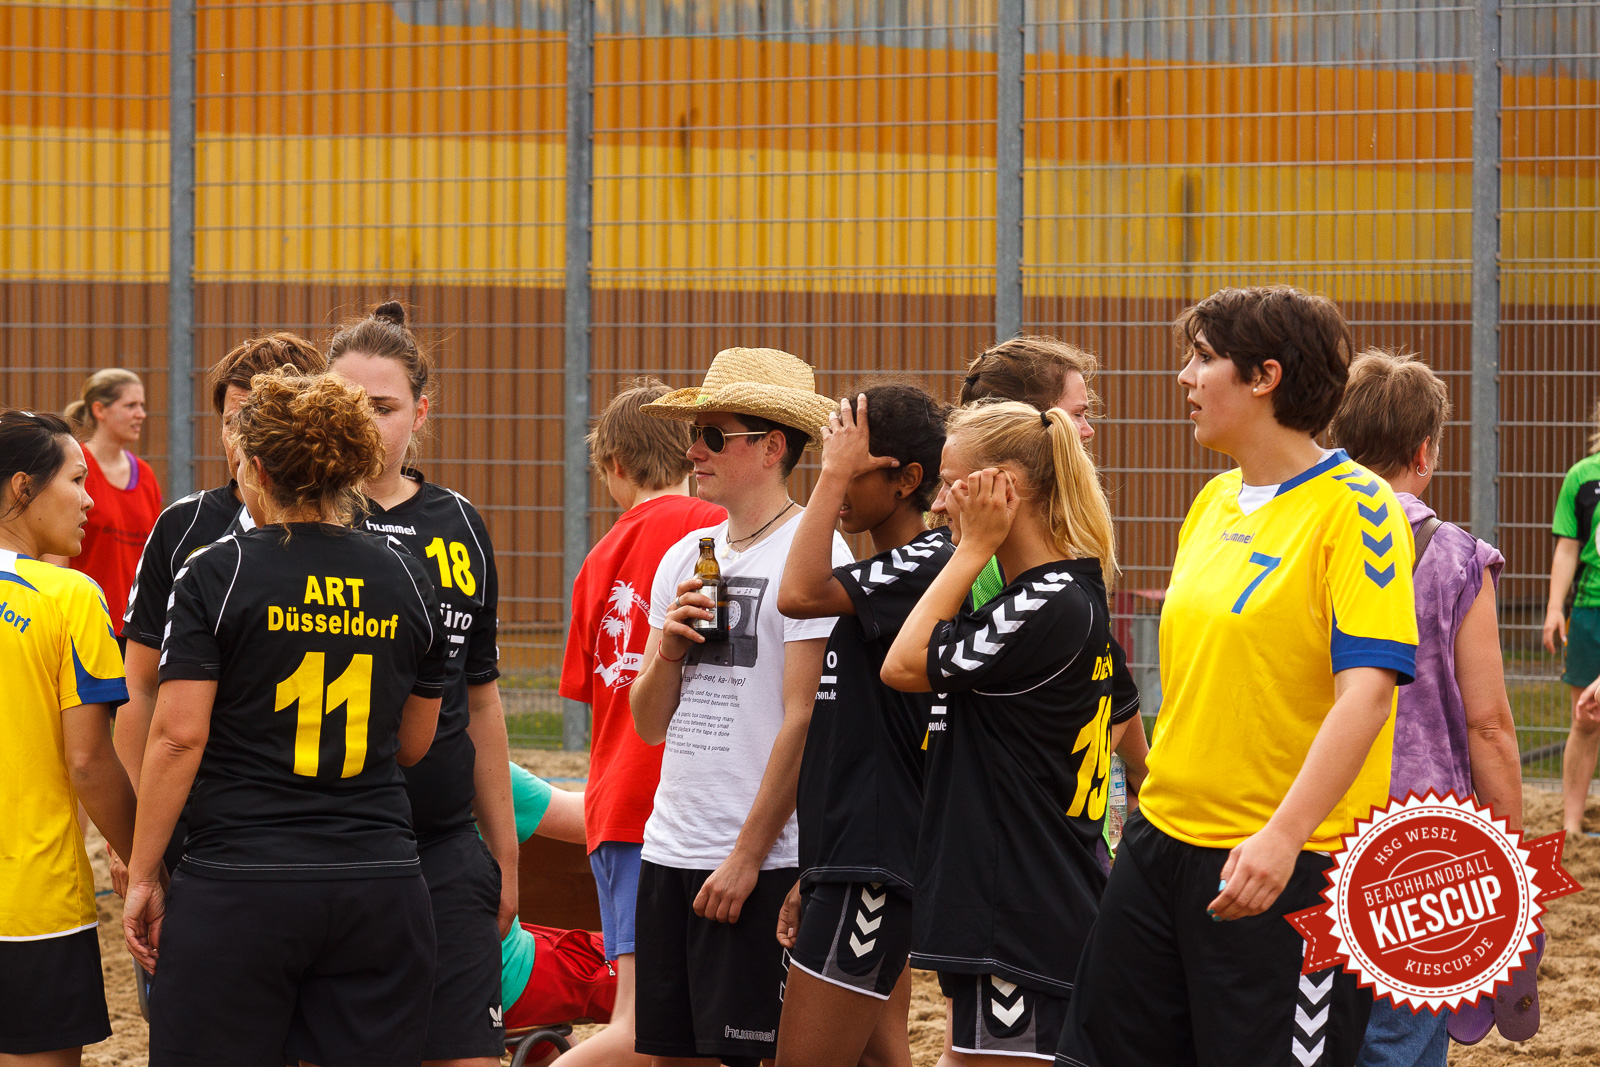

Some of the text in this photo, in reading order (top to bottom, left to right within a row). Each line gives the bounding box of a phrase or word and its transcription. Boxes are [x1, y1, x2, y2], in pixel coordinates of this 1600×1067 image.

[366, 520, 416, 535] hummel
[1220, 530, 1255, 544] hummel
[425, 537, 476, 596] 18
[1231, 551, 1282, 615] 7
[304, 575, 364, 608] ART
[268, 605, 399, 639] Düsseldorf
[440, 603, 472, 630] üro
[274, 651, 373, 778] 11
[725, 1025, 775, 1042] hummel
